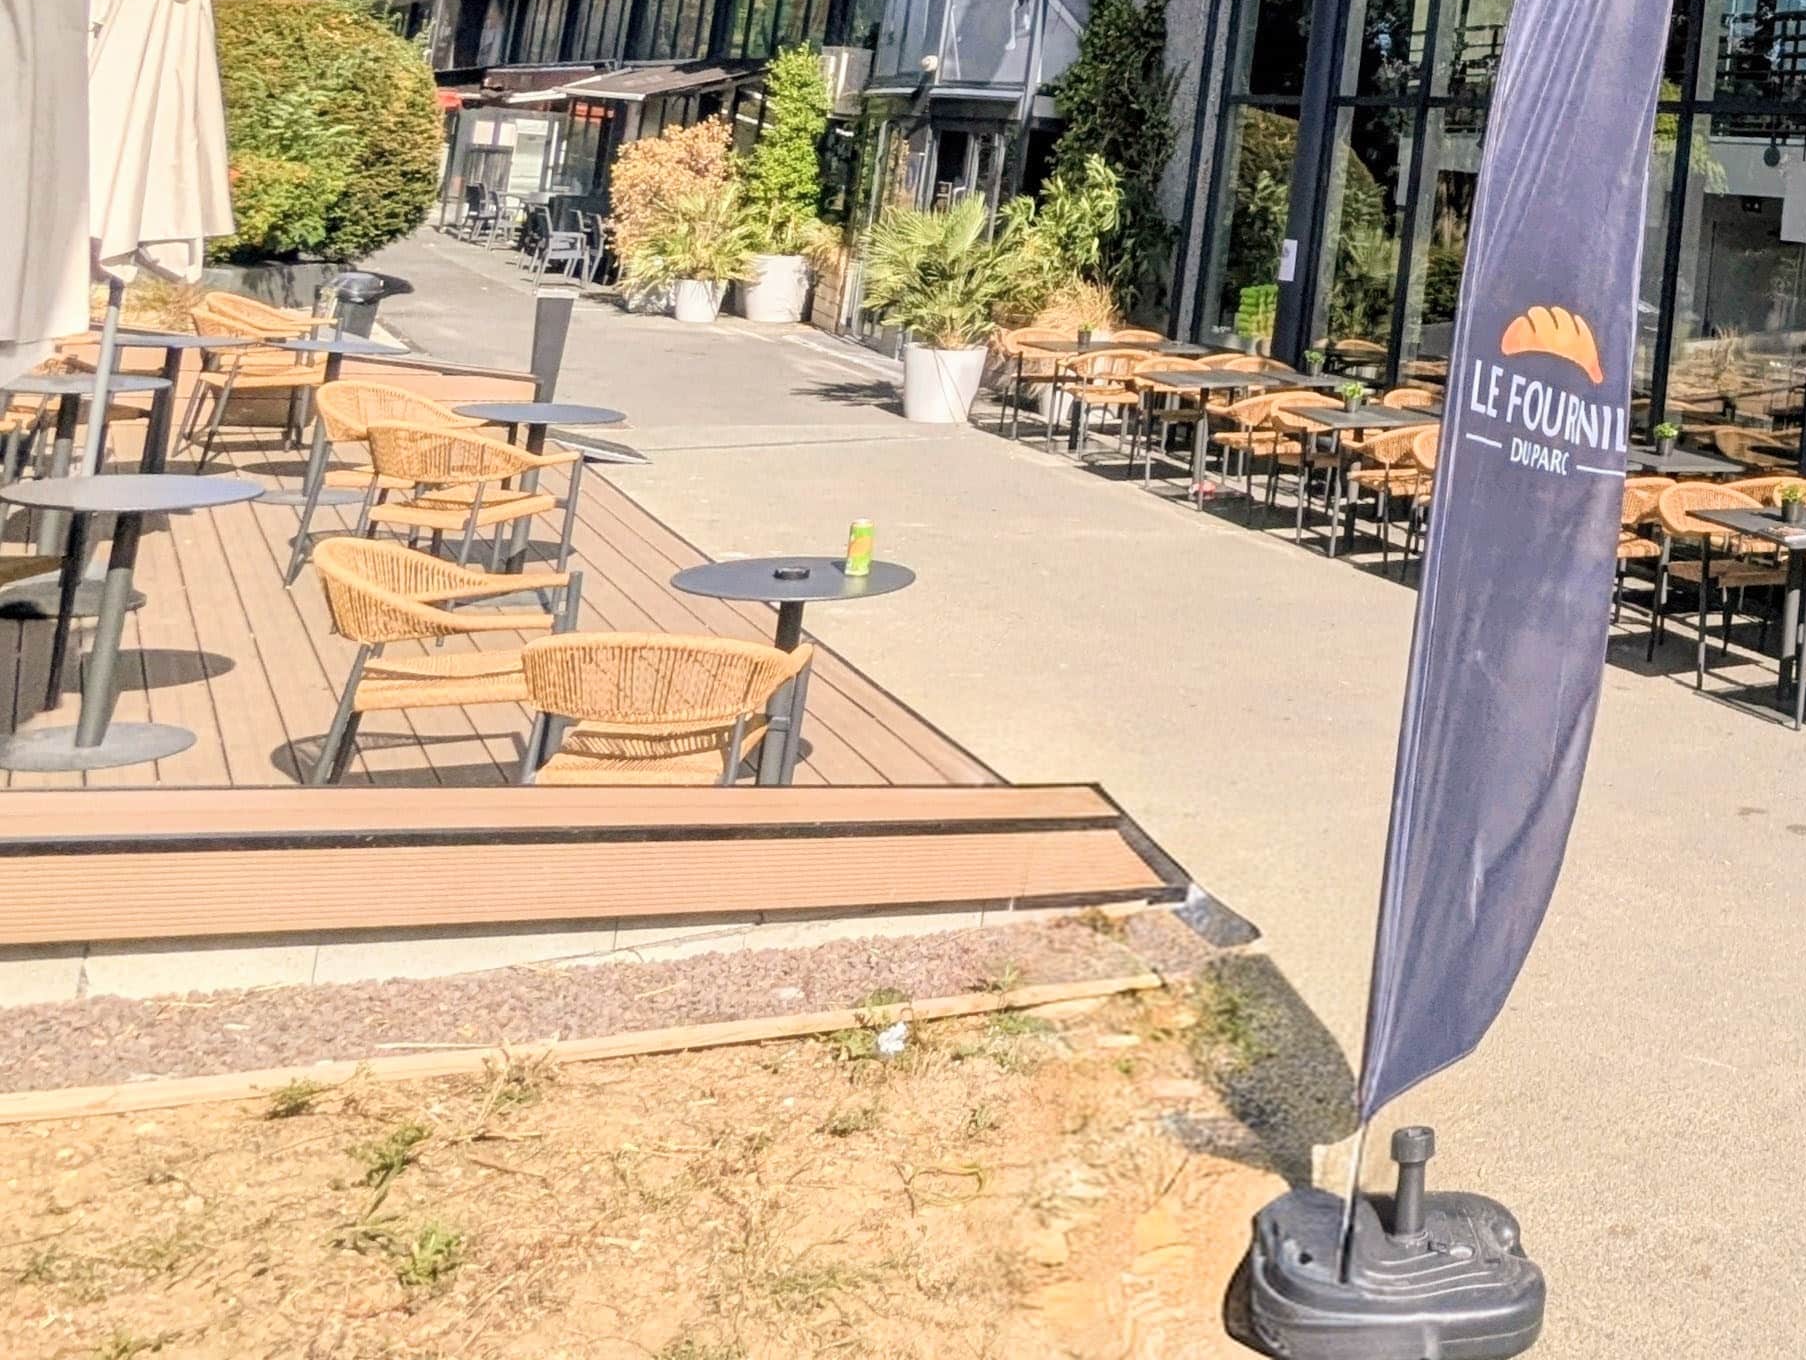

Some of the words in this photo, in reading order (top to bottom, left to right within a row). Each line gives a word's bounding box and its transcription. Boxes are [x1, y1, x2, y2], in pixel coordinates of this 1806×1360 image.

[1470, 359, 1504, 418] LE
[1506, 374, 1627, 453] FOURNIL
[1510, 437, 1532, 465] DU
[1531, 442, 1570, 475] PARC
